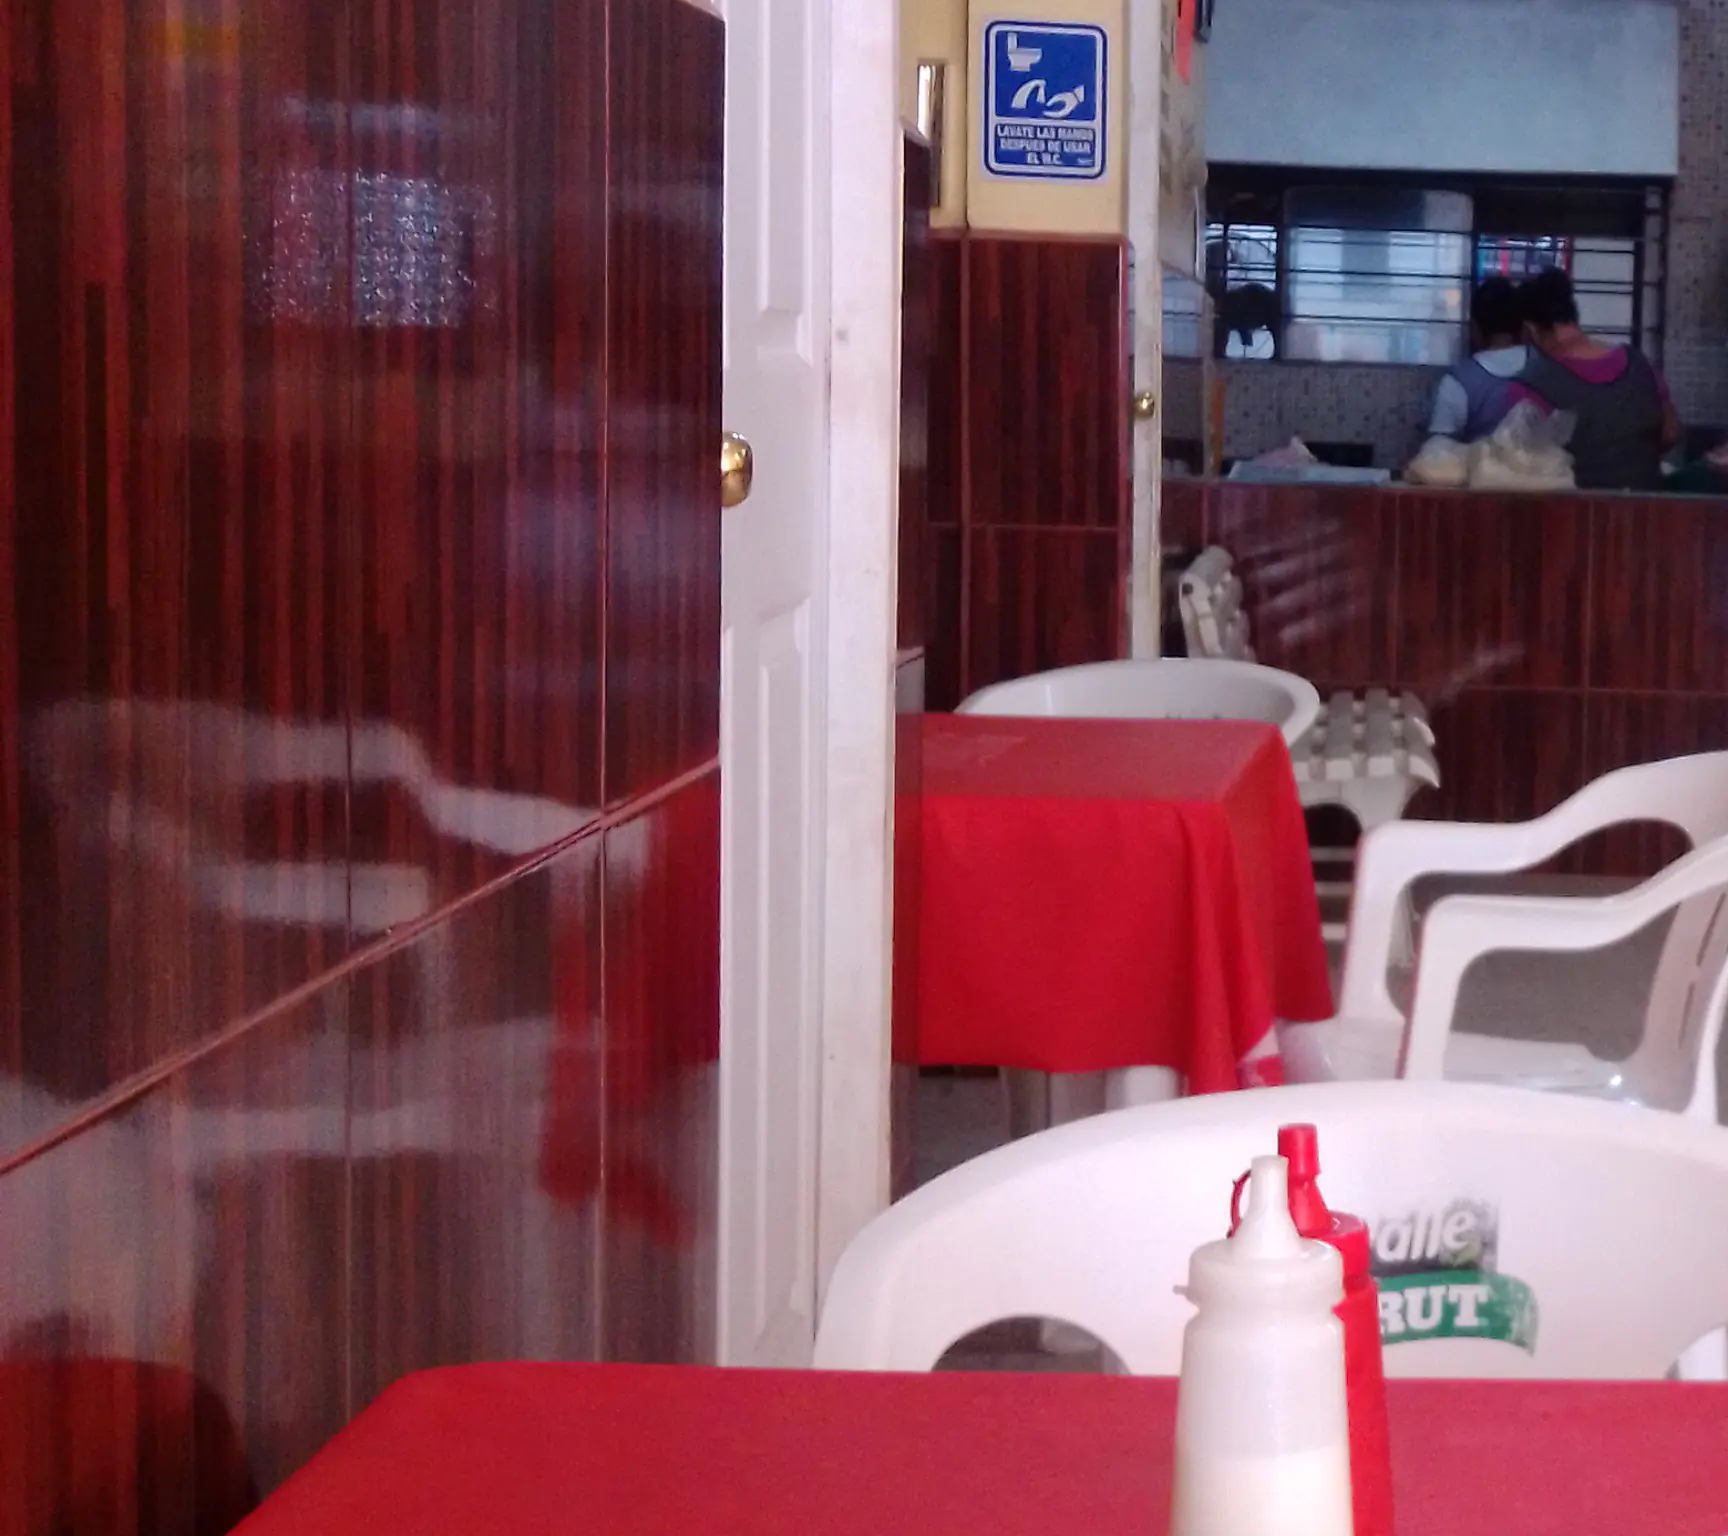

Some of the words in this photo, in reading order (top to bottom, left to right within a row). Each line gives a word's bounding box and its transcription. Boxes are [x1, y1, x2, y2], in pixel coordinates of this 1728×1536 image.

[997, 124, 1034, 138] LAVATE
[1037, 125, 1056, 139] LAS
[1047, 140, 1061, 153] DE
[1027, 151, 1039, 164] EL
[1369, 1209, 1477, 1263] alle
[1378, 1282, 1490, 1336] RUT
